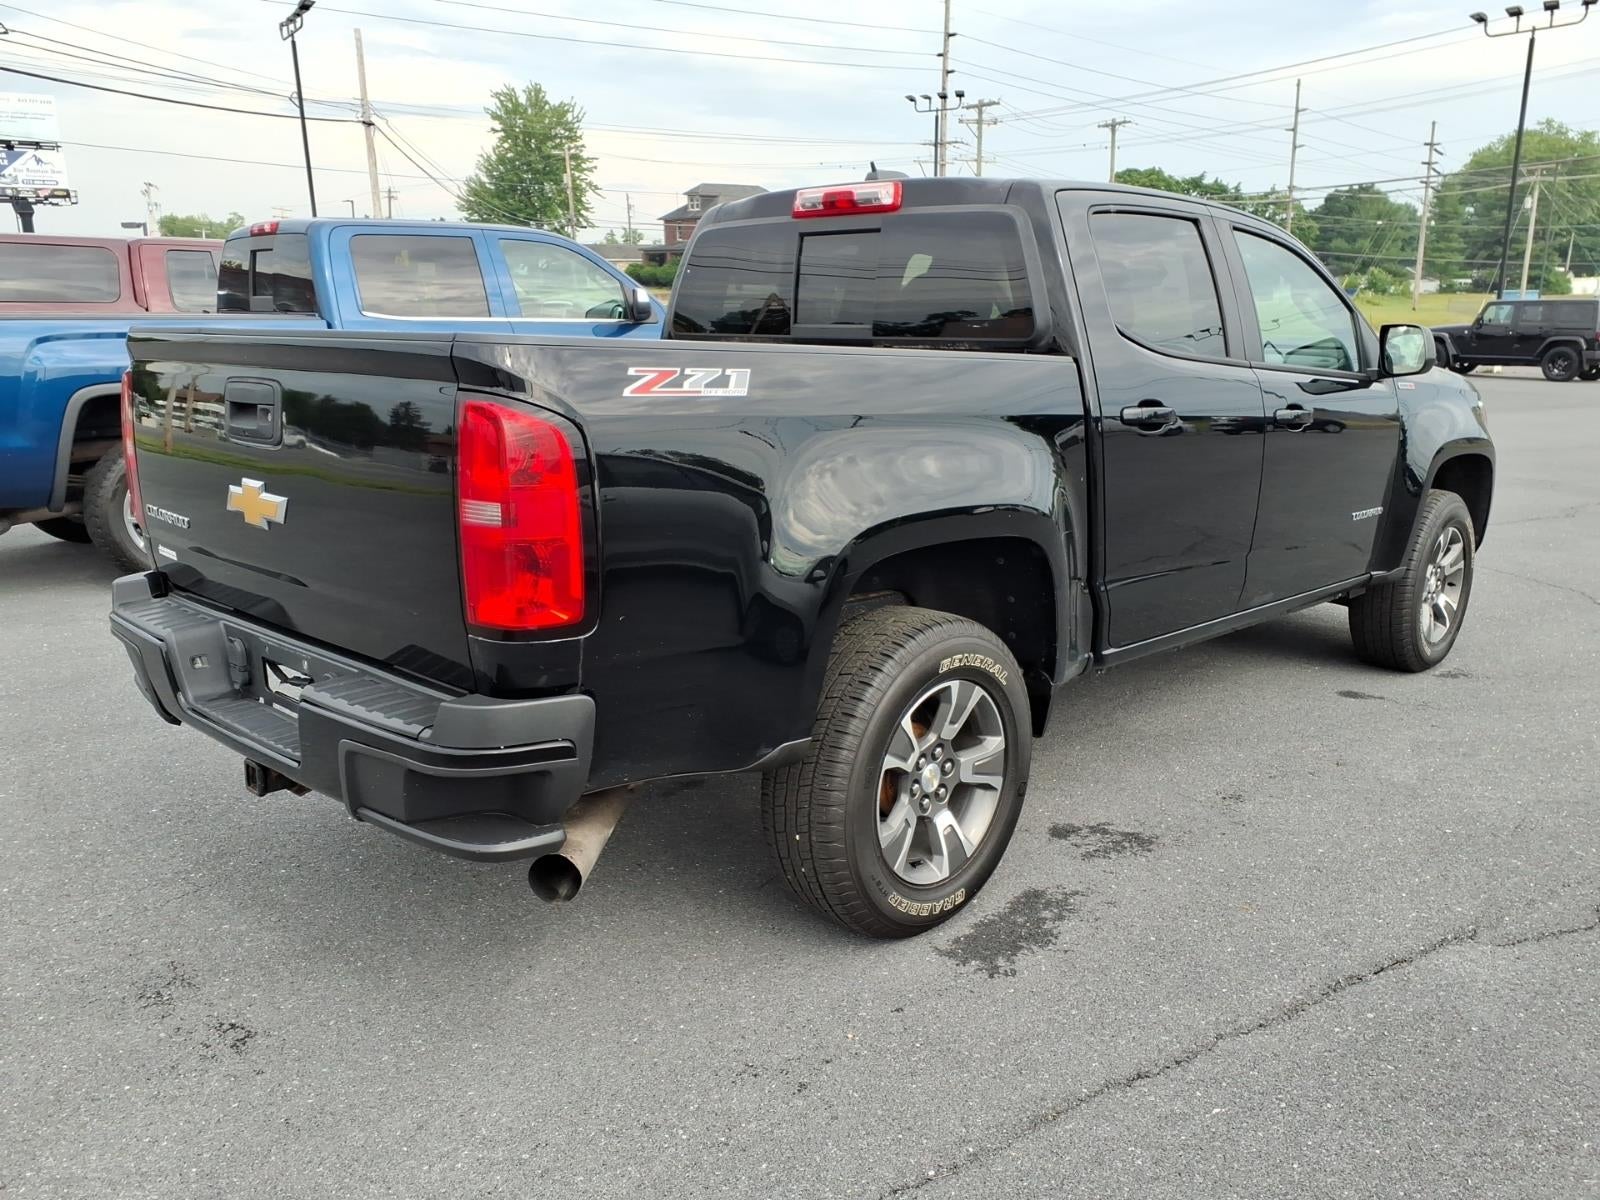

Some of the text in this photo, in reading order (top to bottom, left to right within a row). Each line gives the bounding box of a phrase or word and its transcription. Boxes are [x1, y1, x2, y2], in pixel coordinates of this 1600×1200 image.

[623, 367, 751, 396] Z71
[939, 653, 1008, 686] GENERAL
[888, 888, 965, 916] GRABBER
